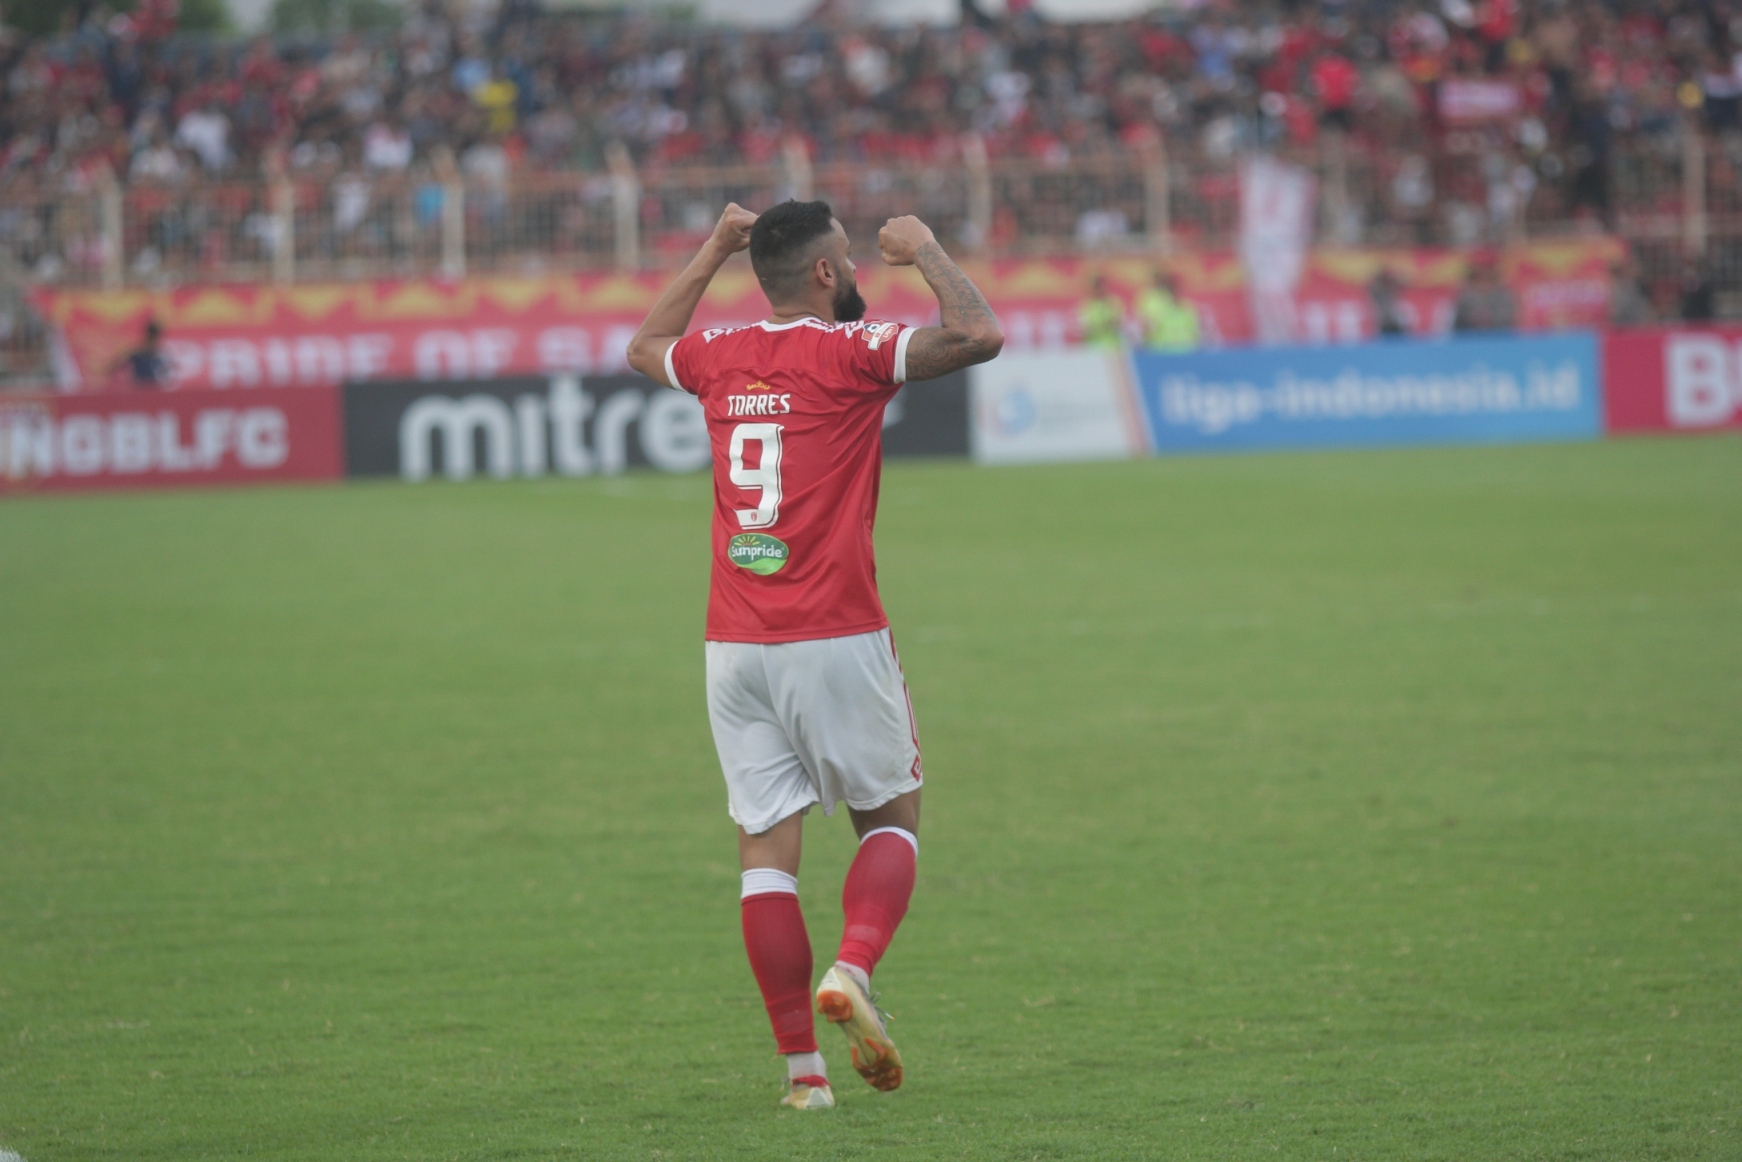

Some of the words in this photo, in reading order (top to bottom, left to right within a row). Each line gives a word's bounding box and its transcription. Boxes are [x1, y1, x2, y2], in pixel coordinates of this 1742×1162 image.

[397, 374, 711, 481] mitre
[727, 393, 791, 416] TORRES
[1663, 331, 1742, 428] B
[729, 422, 785, 530] 9
[731, 544, 783, 560] Sunpride
